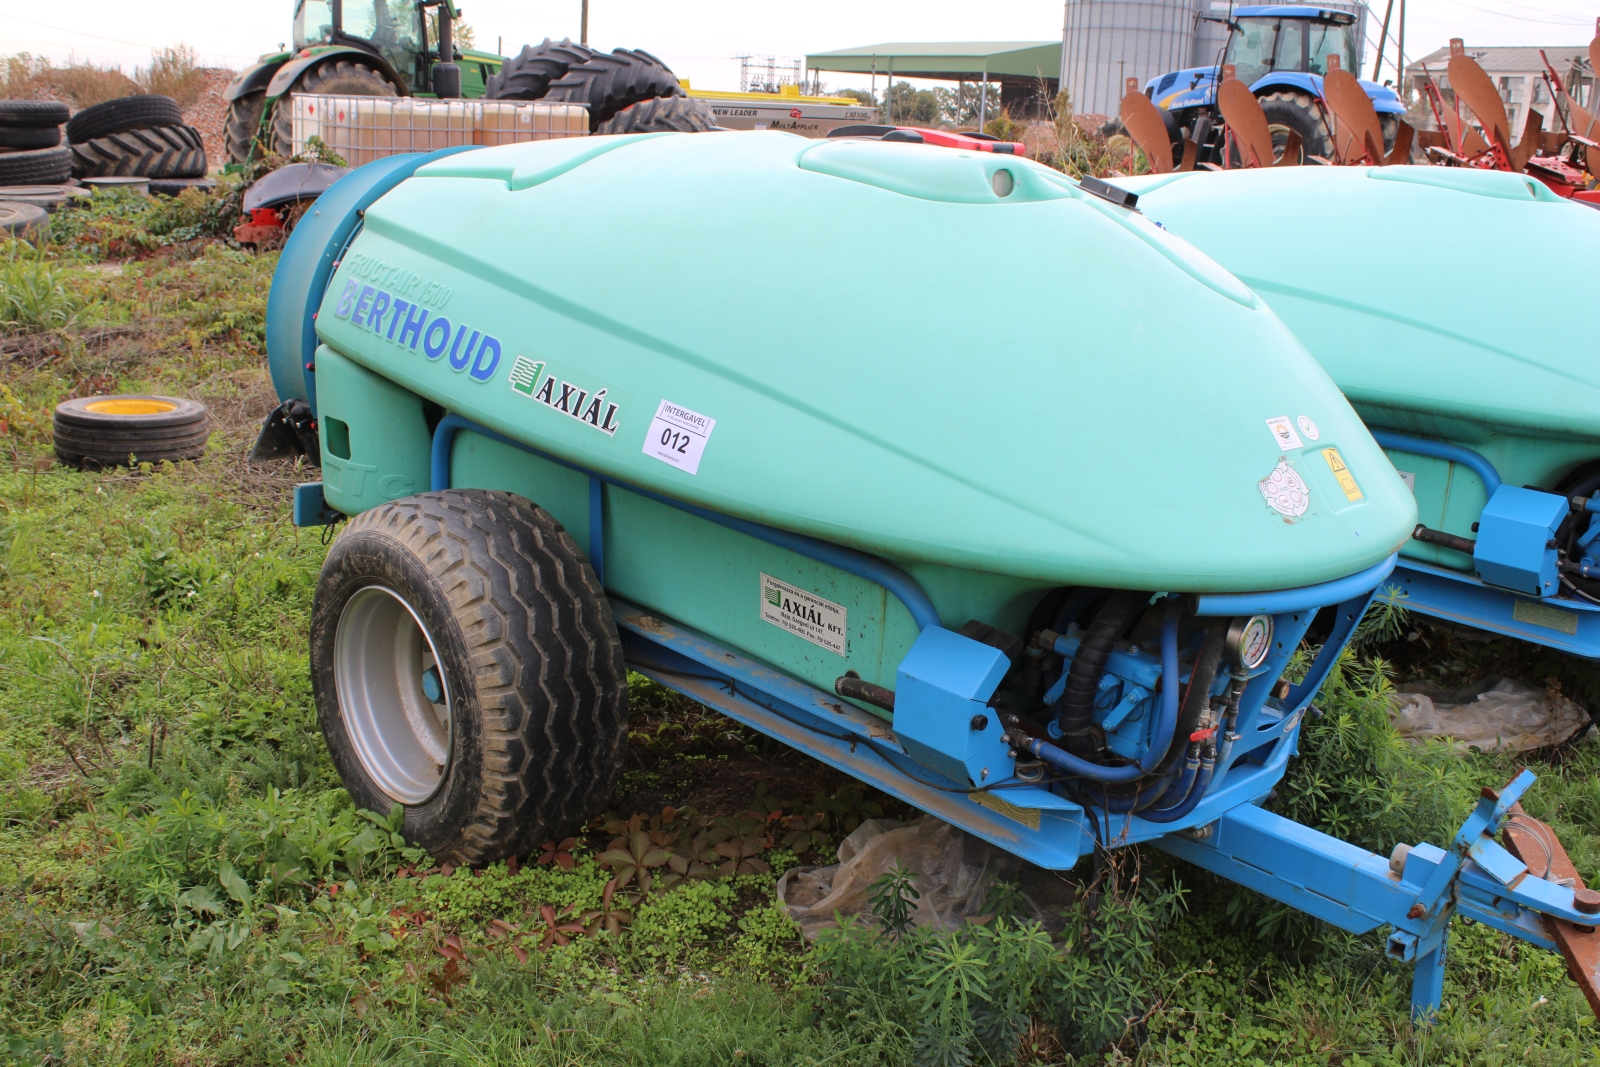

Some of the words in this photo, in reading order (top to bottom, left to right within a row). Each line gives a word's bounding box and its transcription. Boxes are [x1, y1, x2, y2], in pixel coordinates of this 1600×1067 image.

[712, 108, 729, 116] NEW
[730, 109, 758, 117] LEADER
[1172, 101, 1184, 109] New
[1184, 98, 1204, 106] Holland
[346, 252, 422, 297] FRUCTAIR
[418, 278, 454, 310] 1500
[334, 276, 503, 384] BERTHOUD
[534, 376, 619, 434] AXIÁL
[665, 405, 705, 427] INTERGAVEL
[660, 427, 691, 455] 012
[782, 598, 825, 627] AXIÁL
[827, 622, 844, 637] KFT.
